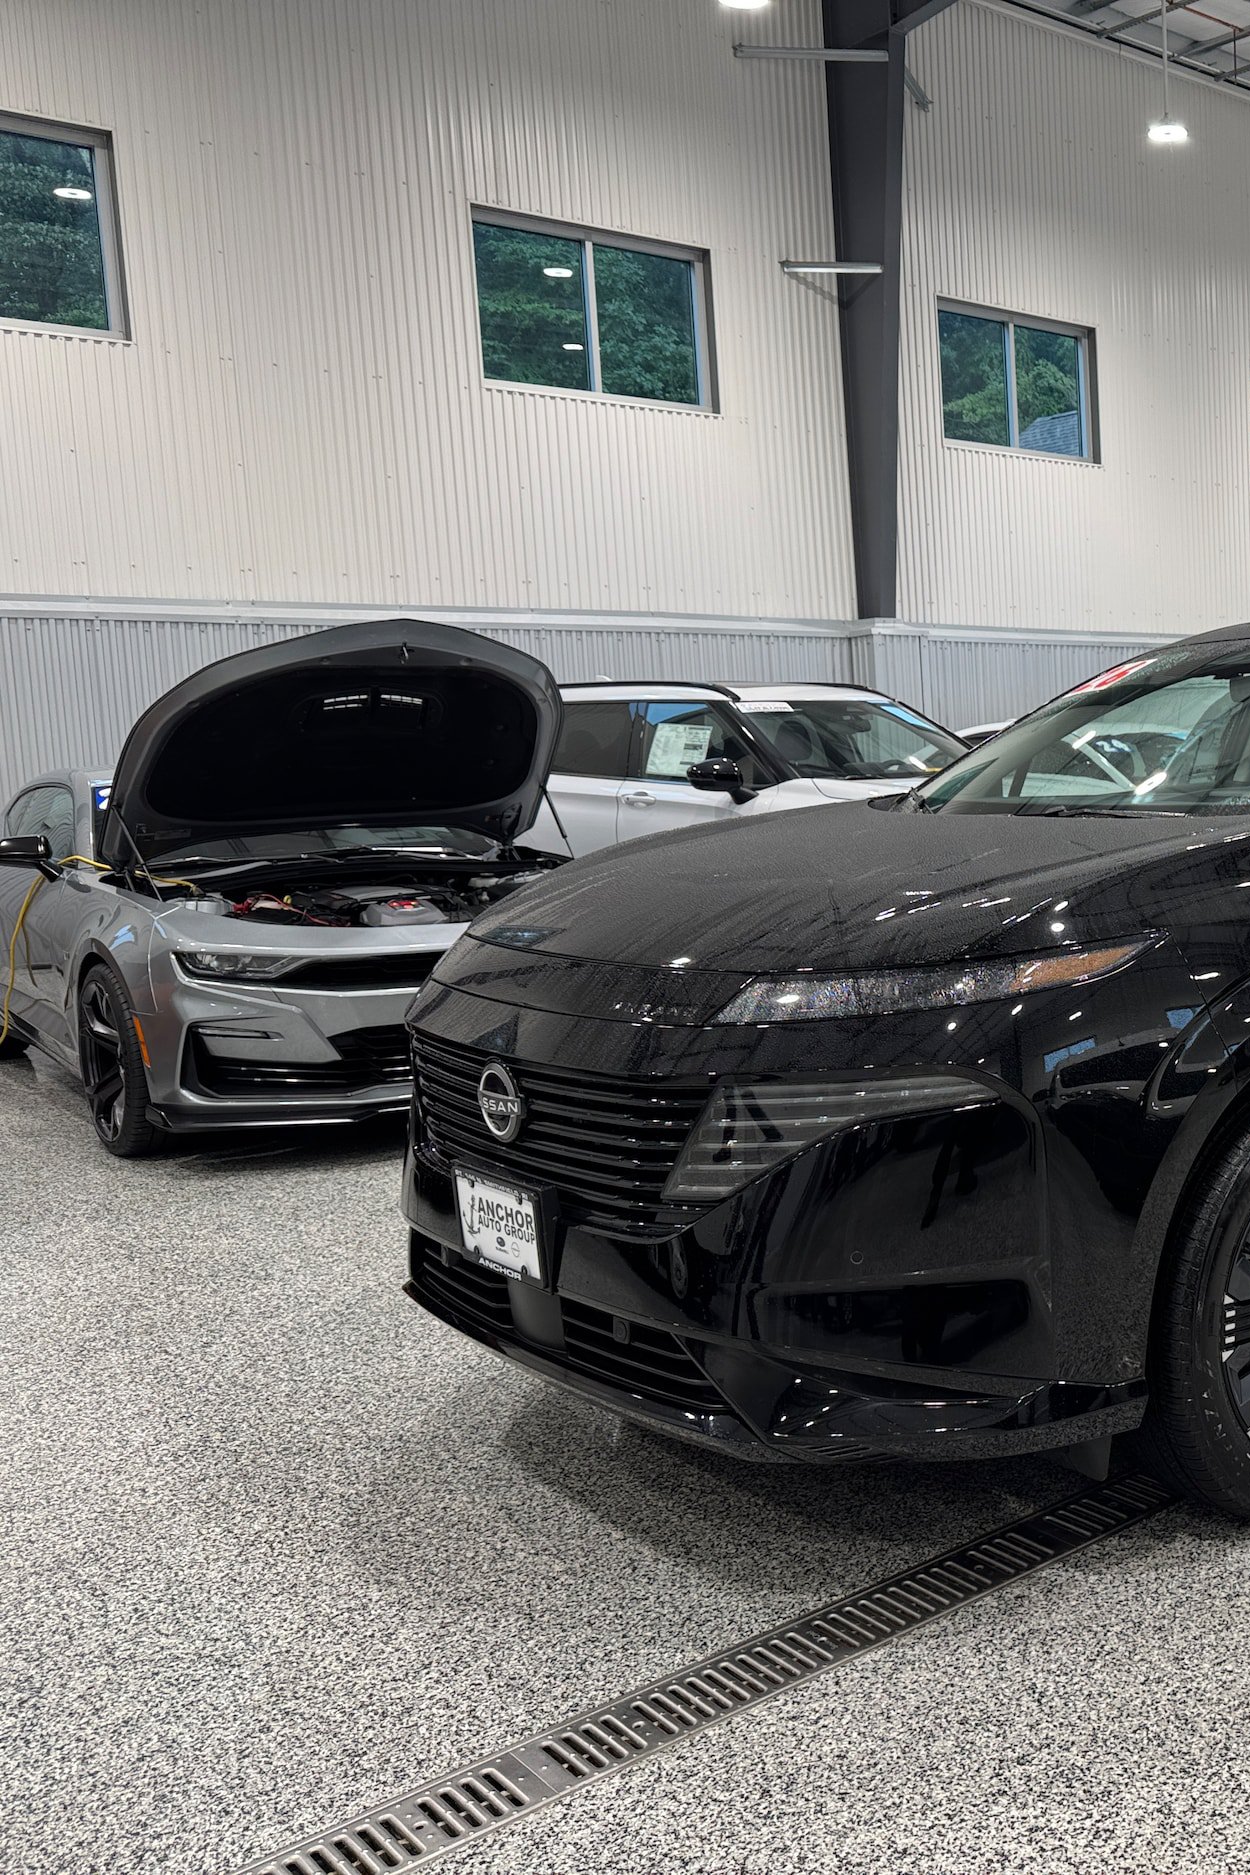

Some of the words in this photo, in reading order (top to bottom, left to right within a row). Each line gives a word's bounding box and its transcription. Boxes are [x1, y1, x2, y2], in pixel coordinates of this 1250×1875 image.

[482, 1096, 518, 1113] SSAN
[478, 1197, 534, 1233] ANCHOR
[478, 1214, 502, 1233] AUTO
[504, 1224, 535, 1245] GROUP
[478, 1257, 522, 1281] ANCHOR
